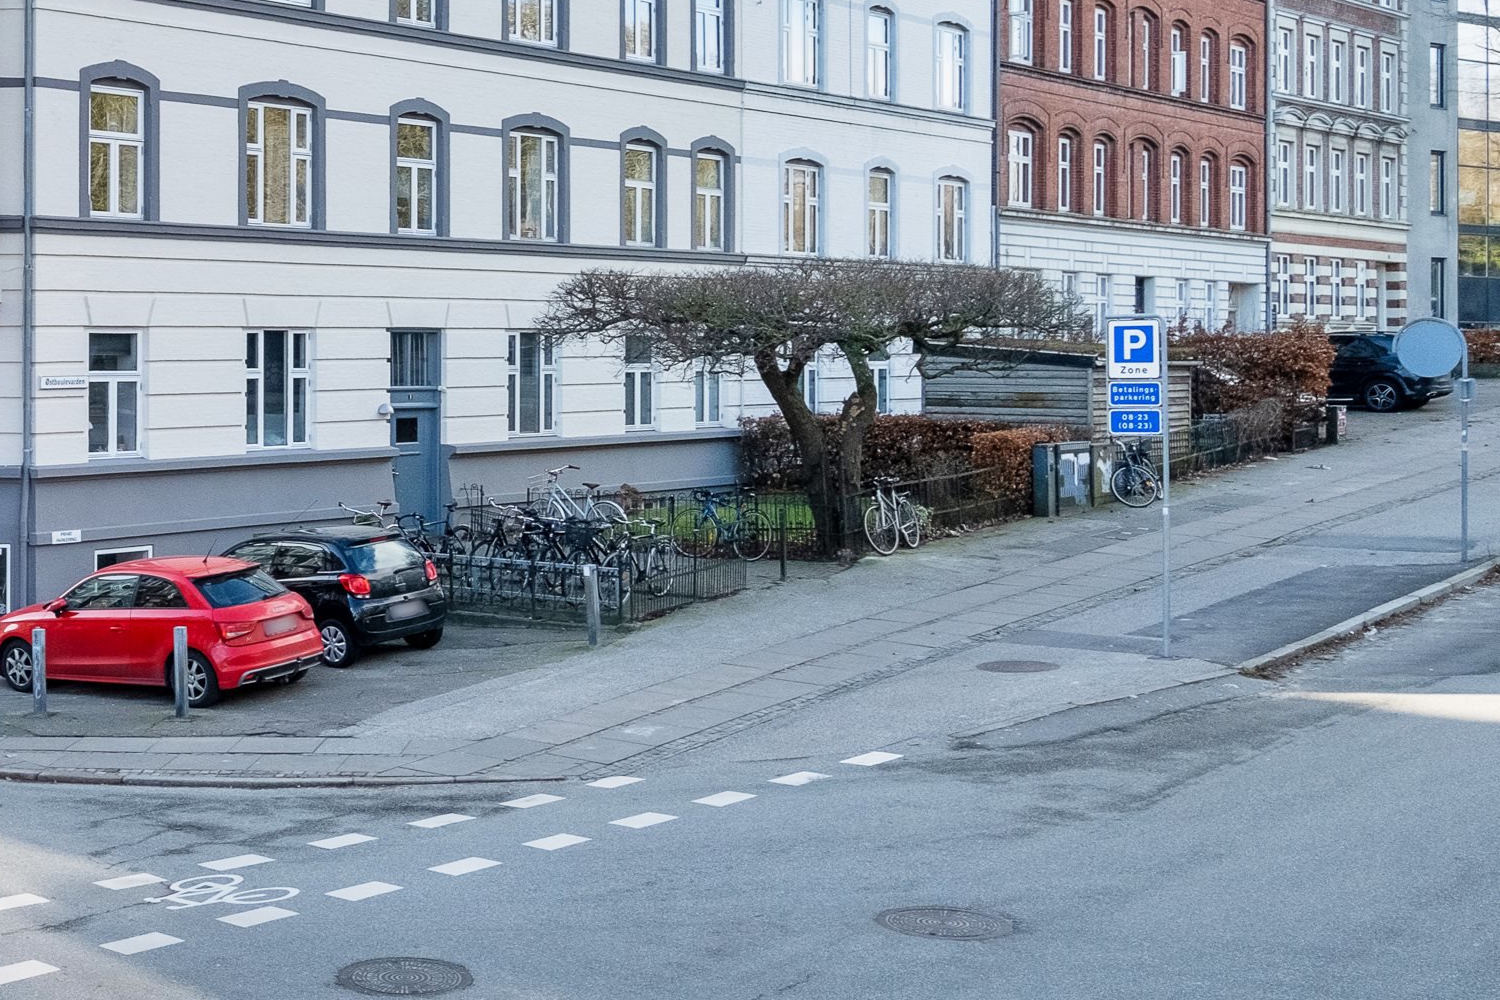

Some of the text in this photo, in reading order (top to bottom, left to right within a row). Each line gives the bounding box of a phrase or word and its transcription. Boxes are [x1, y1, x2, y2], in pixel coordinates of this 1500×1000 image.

[1123, 329, 1147, 360] P
[1120, 366, 1148, 374] Zone
[1112, 386, 1157, 394] Betalings-
[1114, 394, 1156, 402] parkering
[1121, 413, 1149, 421] 08-23
[1118, 422, 1153, 430] (08-23)
